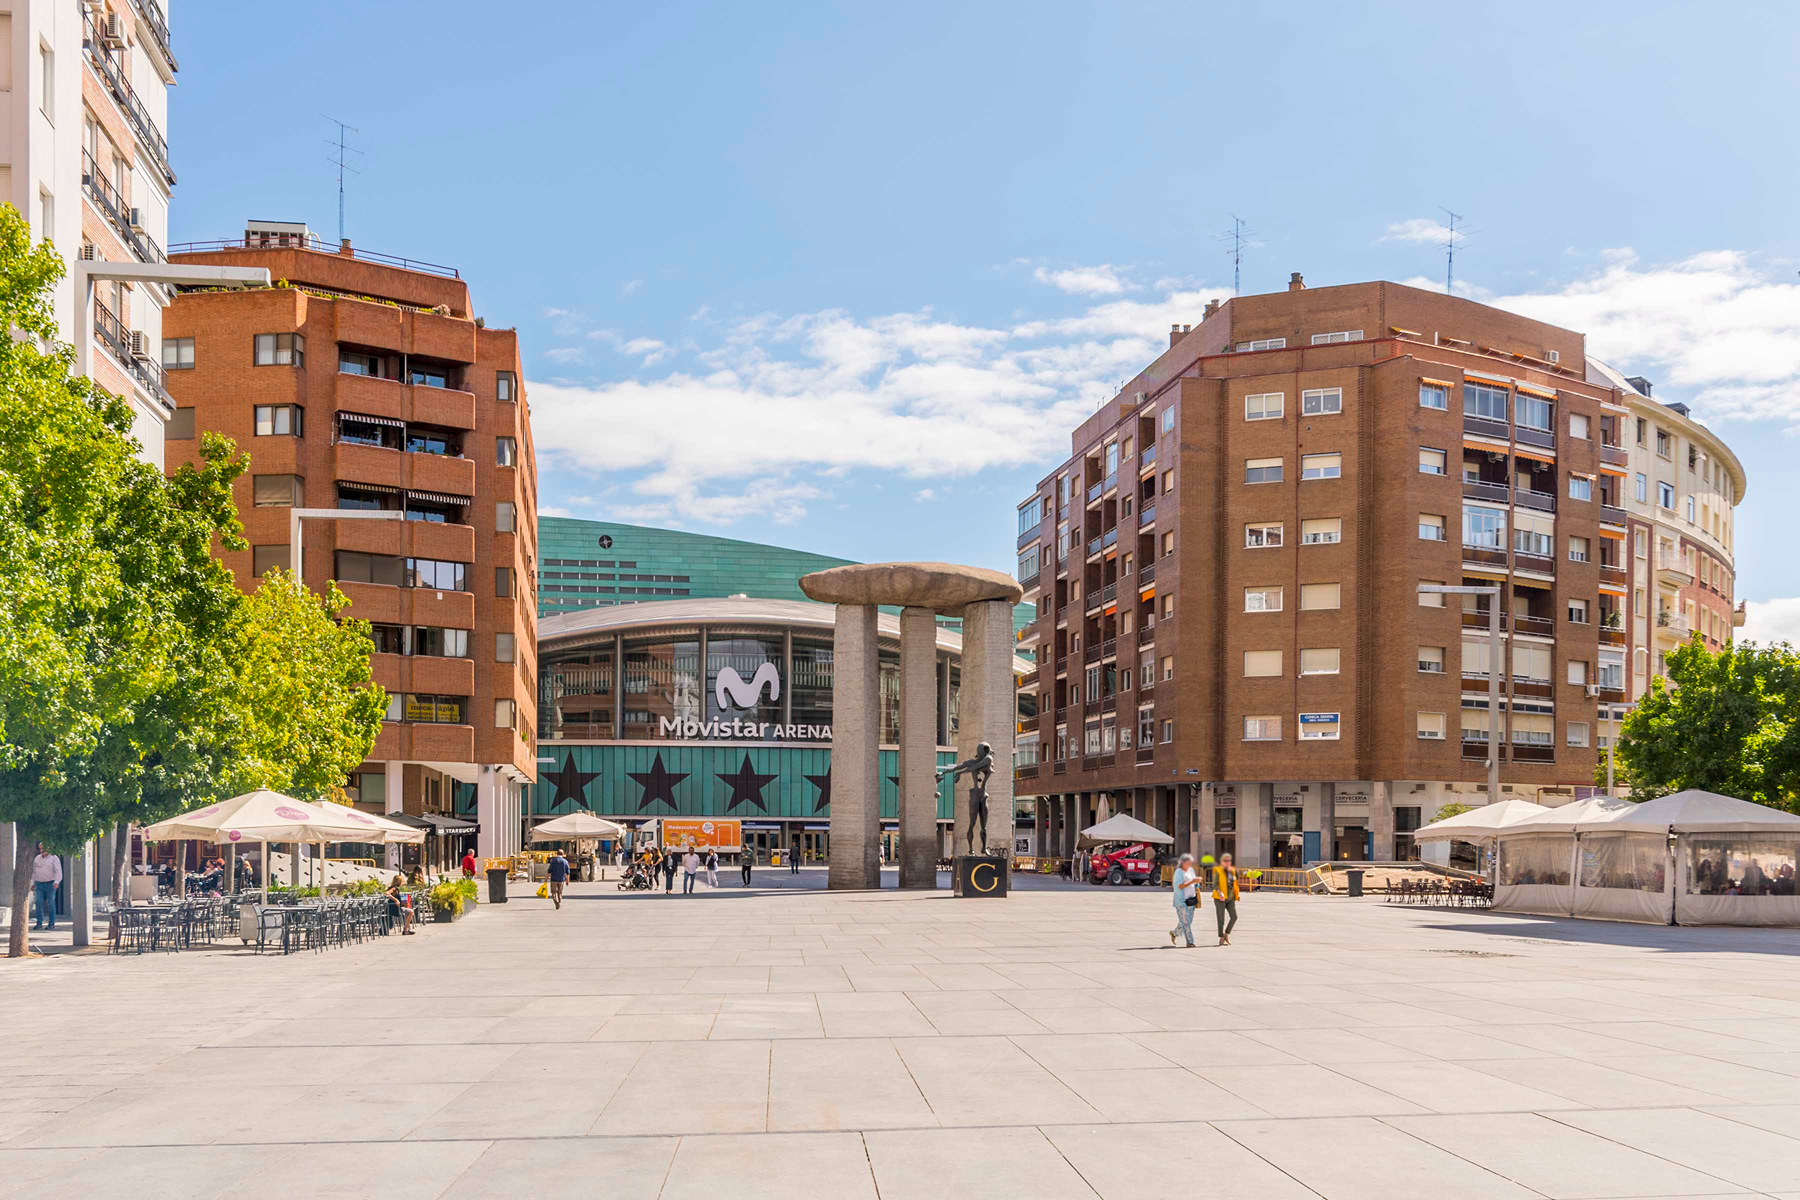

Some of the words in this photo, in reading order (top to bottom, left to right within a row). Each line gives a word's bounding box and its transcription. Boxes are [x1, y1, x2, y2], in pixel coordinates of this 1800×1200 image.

[659, 715, 770, 738] Movistar
[773, 724, 833, 739] ARENA
[971, 862, 999, 892] G
